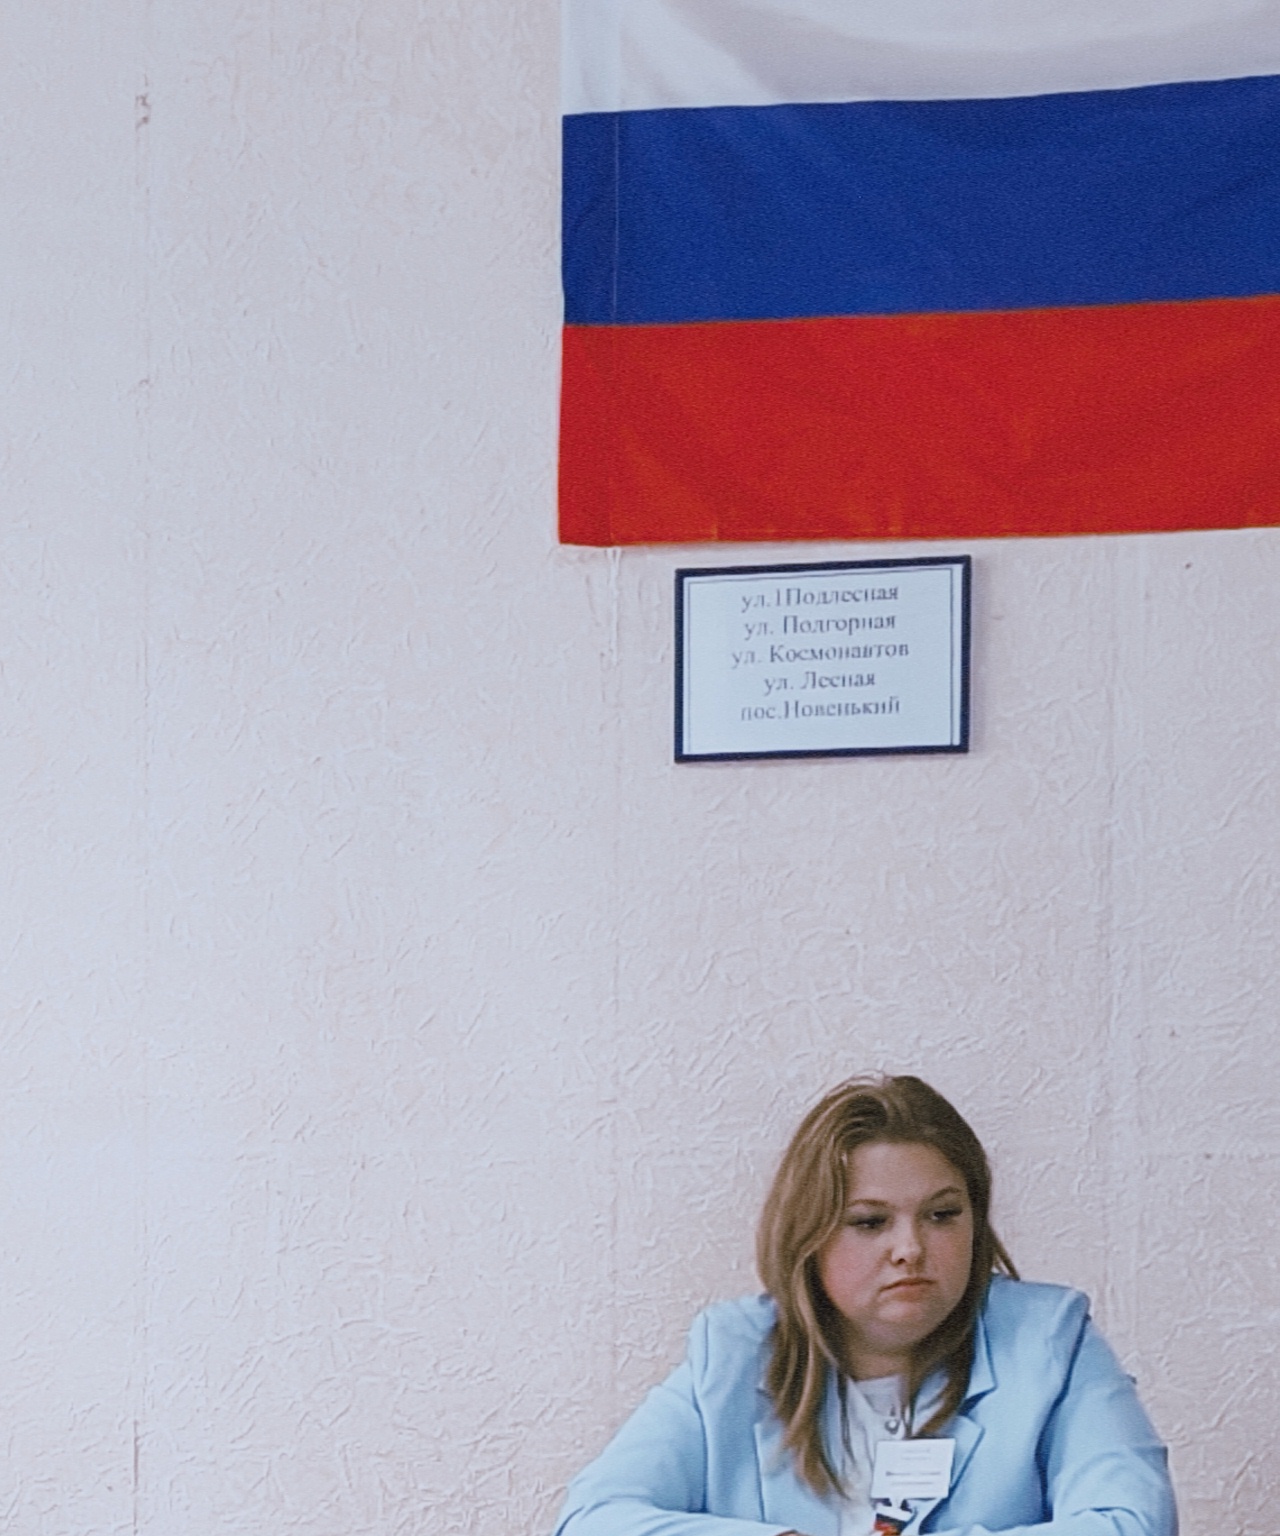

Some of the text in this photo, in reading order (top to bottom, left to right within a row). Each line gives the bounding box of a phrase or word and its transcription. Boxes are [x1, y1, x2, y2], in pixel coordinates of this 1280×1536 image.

[743, 615, 896, 641] ул. Подгорная
[731, 643, 910, 669] ул. Космонавтов
[763, 671, 876, 696] ул. Лесная
